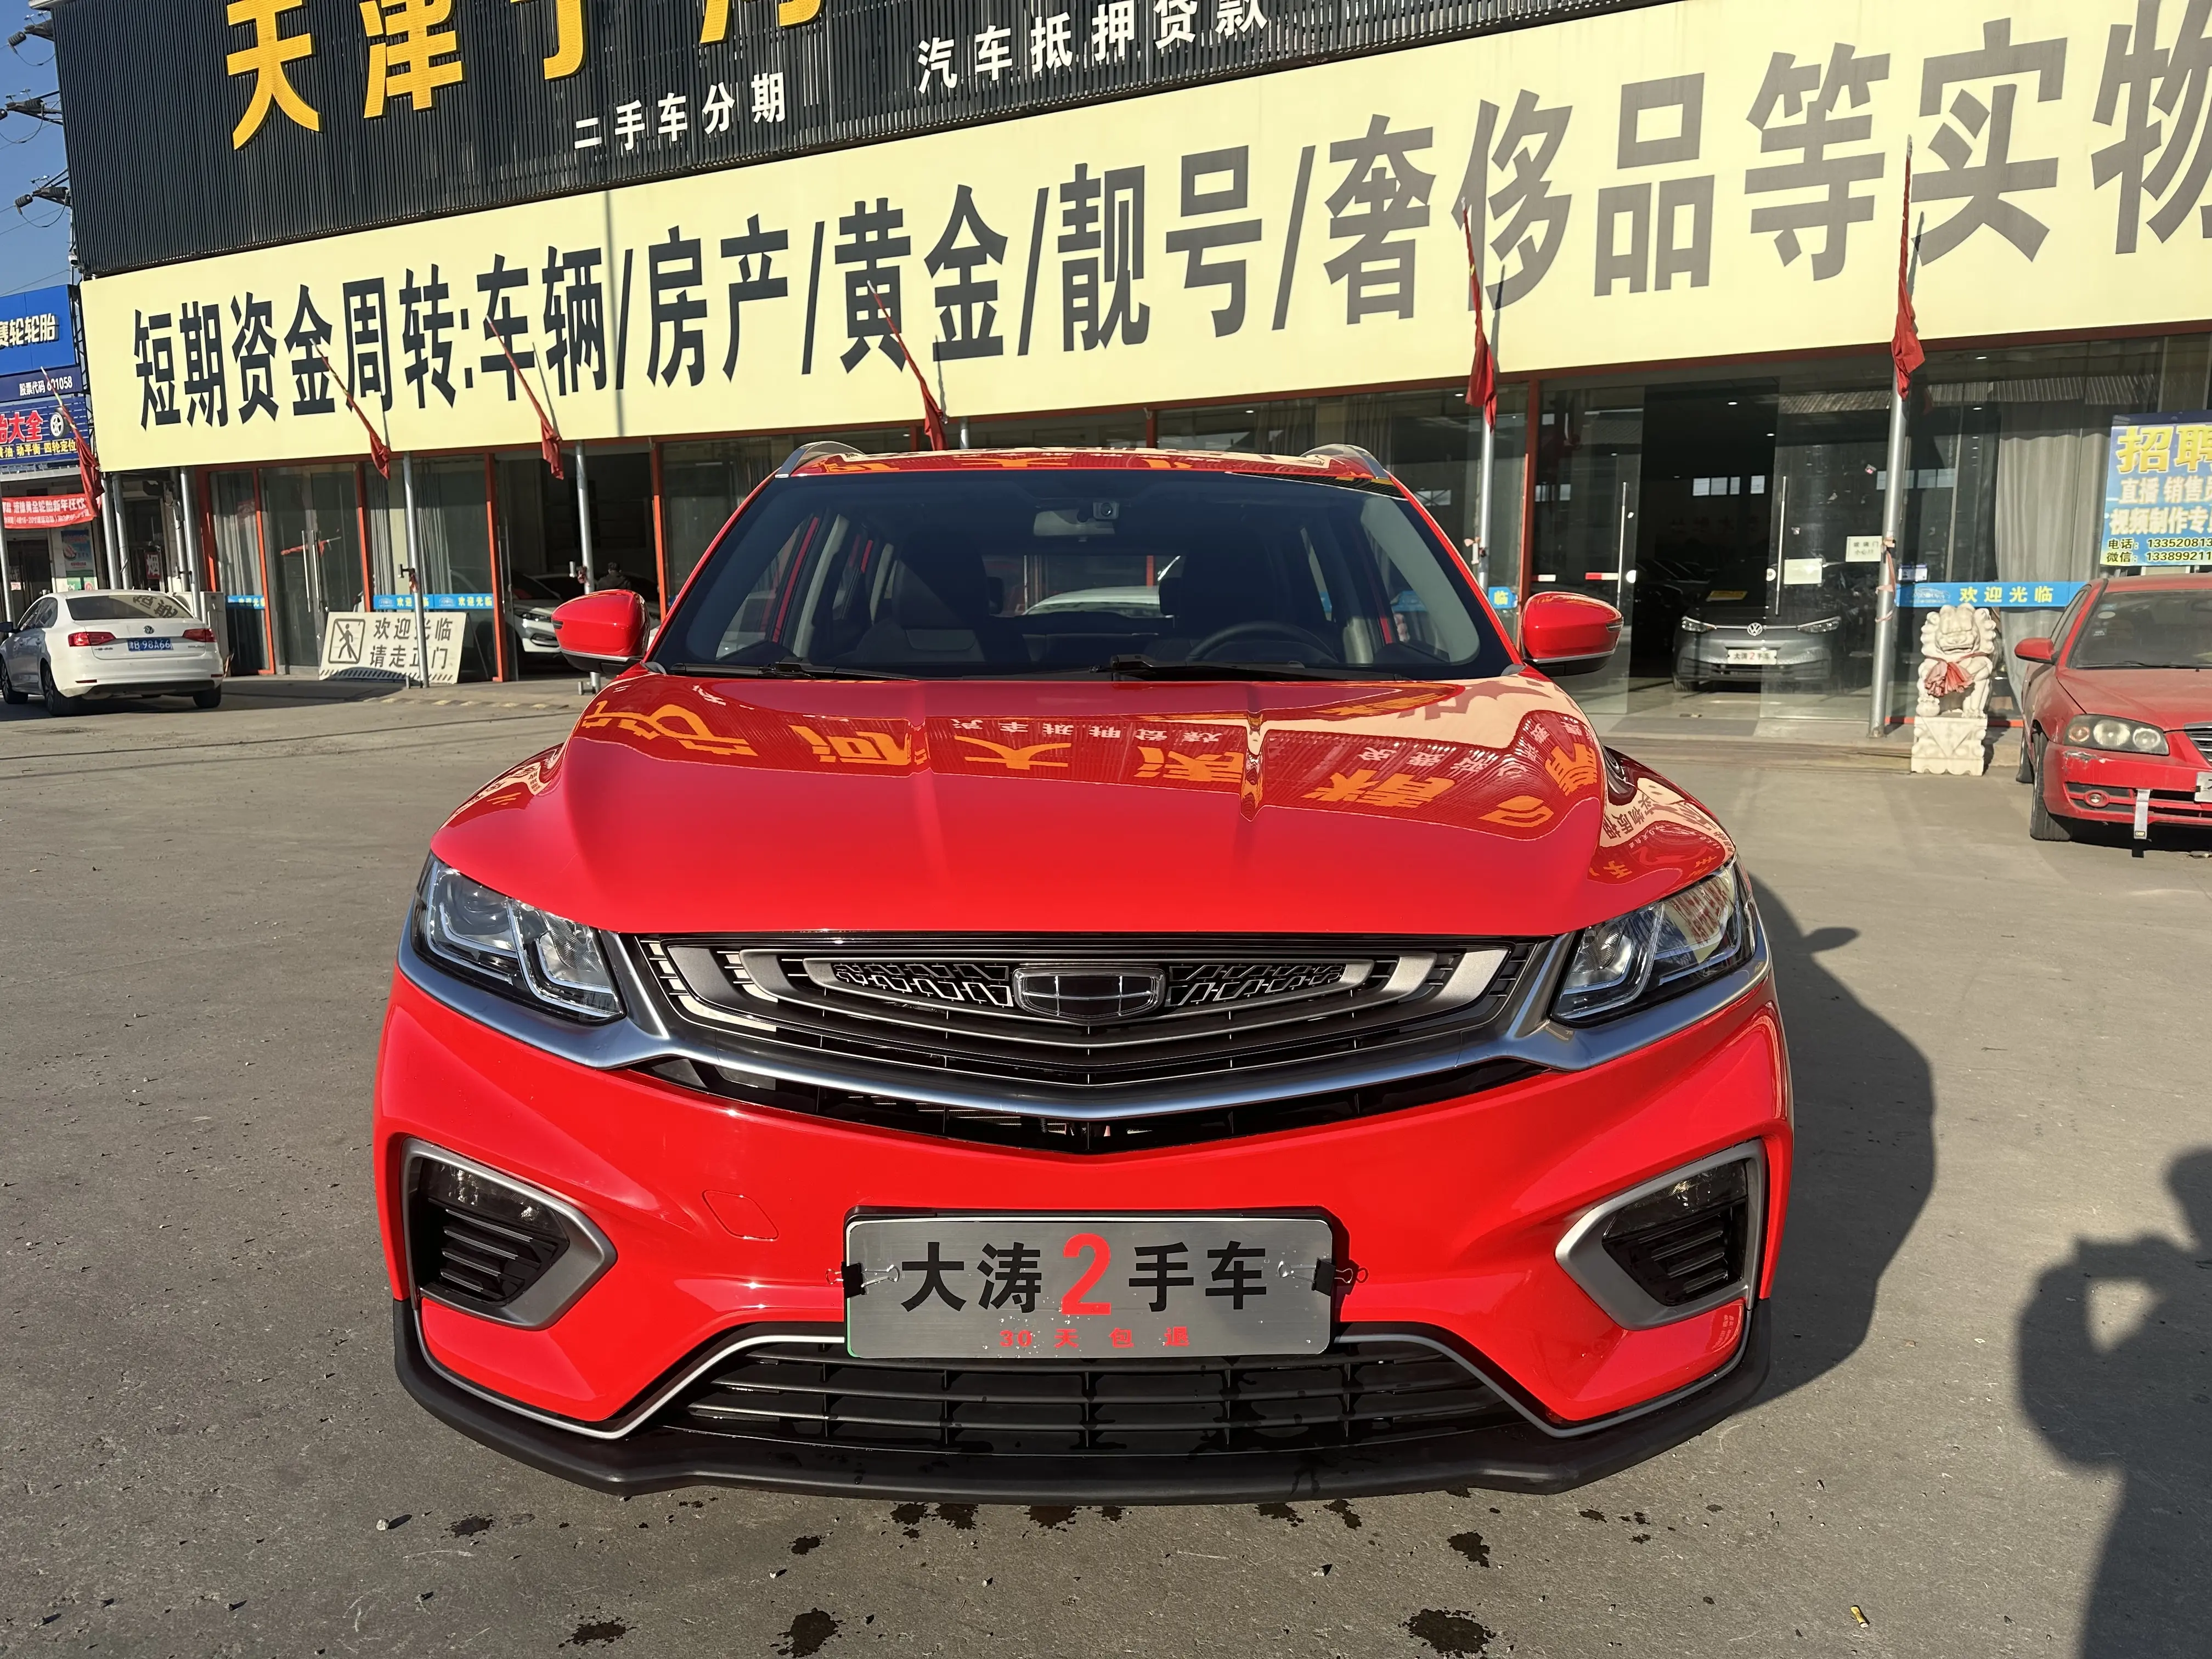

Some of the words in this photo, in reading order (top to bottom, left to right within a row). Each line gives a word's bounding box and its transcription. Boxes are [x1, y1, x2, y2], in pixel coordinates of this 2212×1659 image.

[918, 0, 1268, 93] 汽车抵押贷款
[574, 71, 785, 150] 二手车分期
[19, 380, 46, 396] 股票代码
[44, 439, 77, 453] 四轮定位
[2118, 477, 2159, 504] 直播
[2109, 506, 2212, 535] 视频制作专
[458, 596, 492, 606] 欢迎光临
[1959, 585, 2053, 603] 欢迎光临
[901, 1233, 1268, 1316] 大涛2手车
[999, 1326, 1190, 1349] 30天包退
